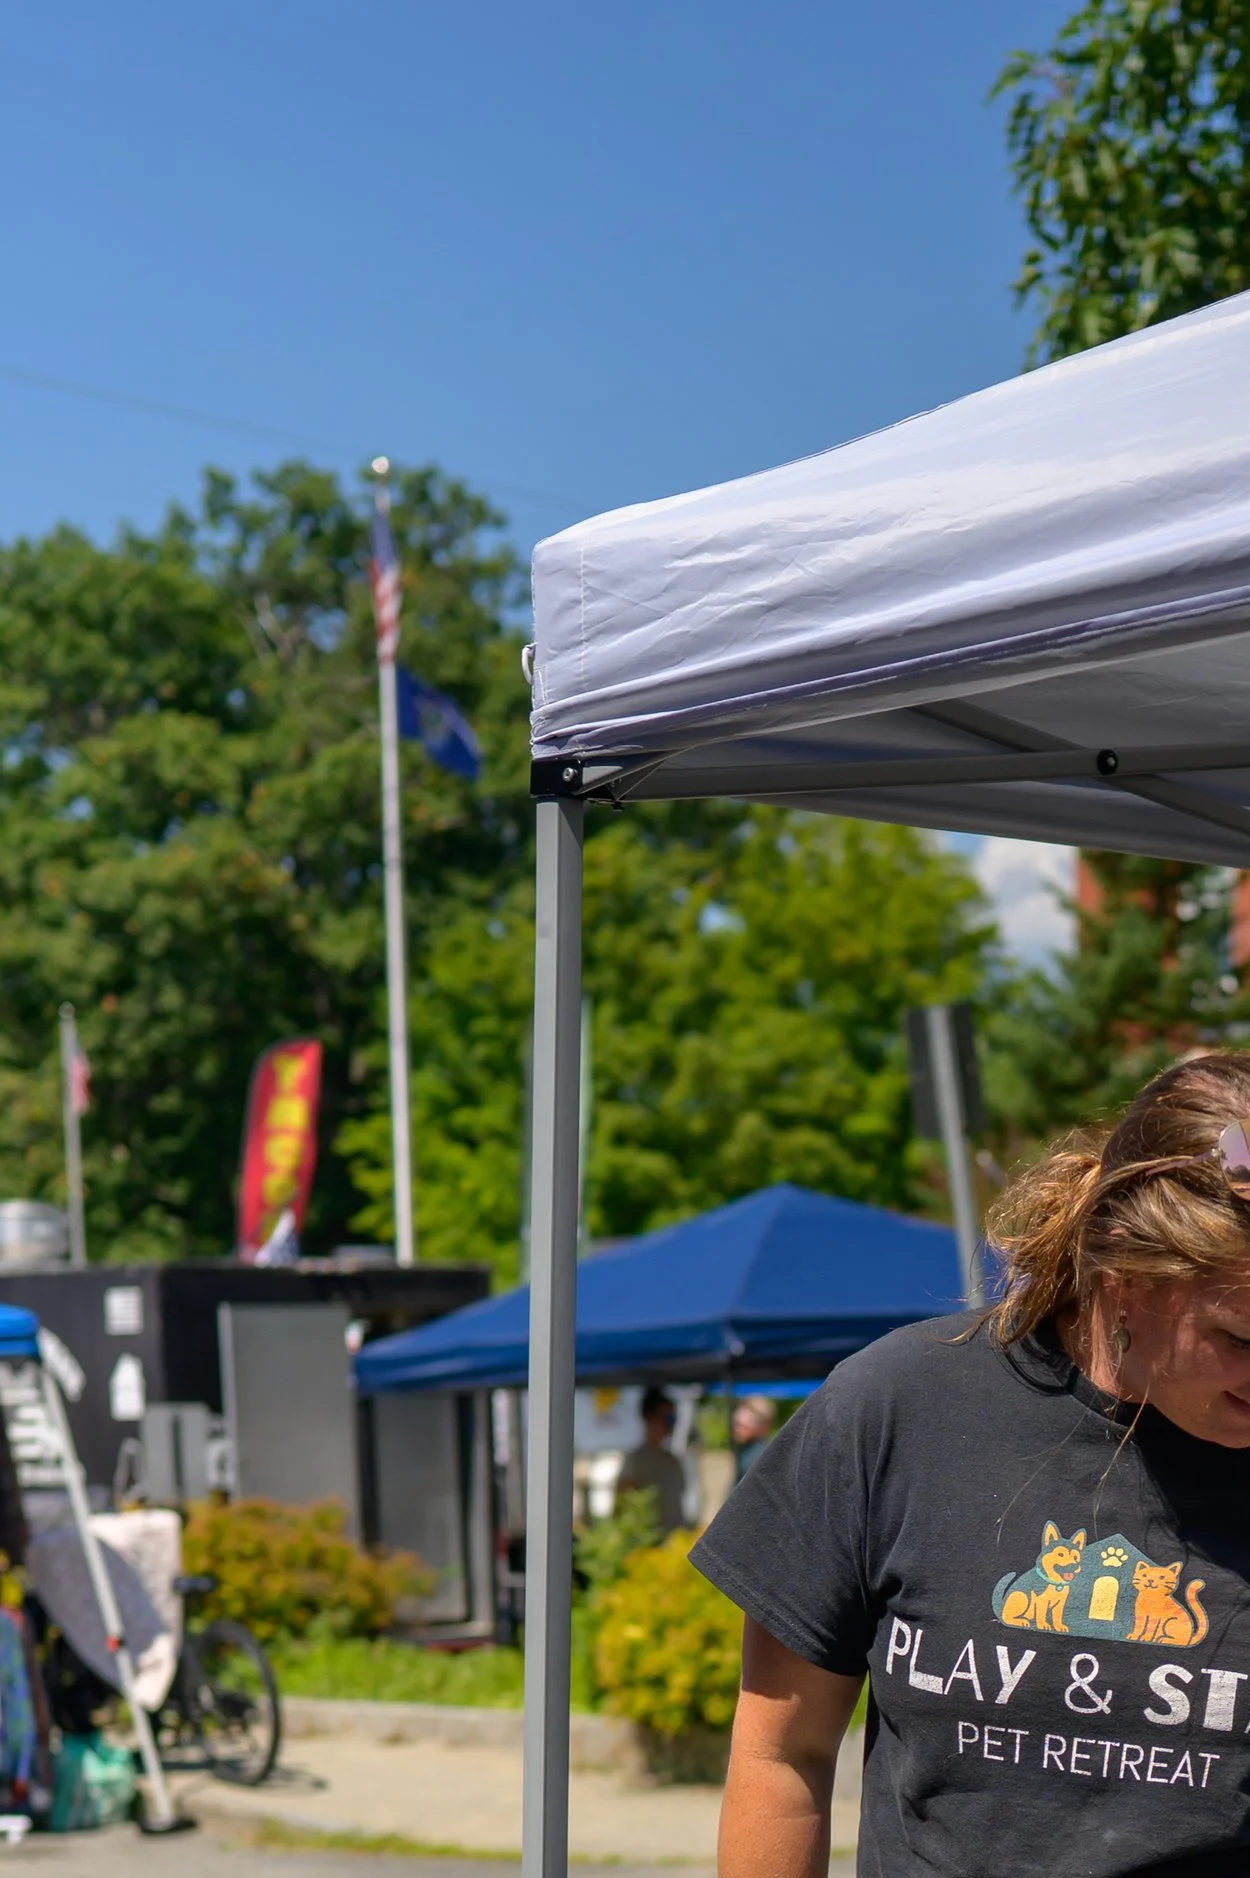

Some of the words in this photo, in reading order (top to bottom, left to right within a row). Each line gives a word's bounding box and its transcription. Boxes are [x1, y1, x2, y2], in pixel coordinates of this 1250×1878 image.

[885, 1616, 1038, 1705] PLAY
[1063, 1652, 1114, 1715] &
[957, 1720, 1030, 1764] PET
[1041, 1733, 1221, 1789] RETREAT
